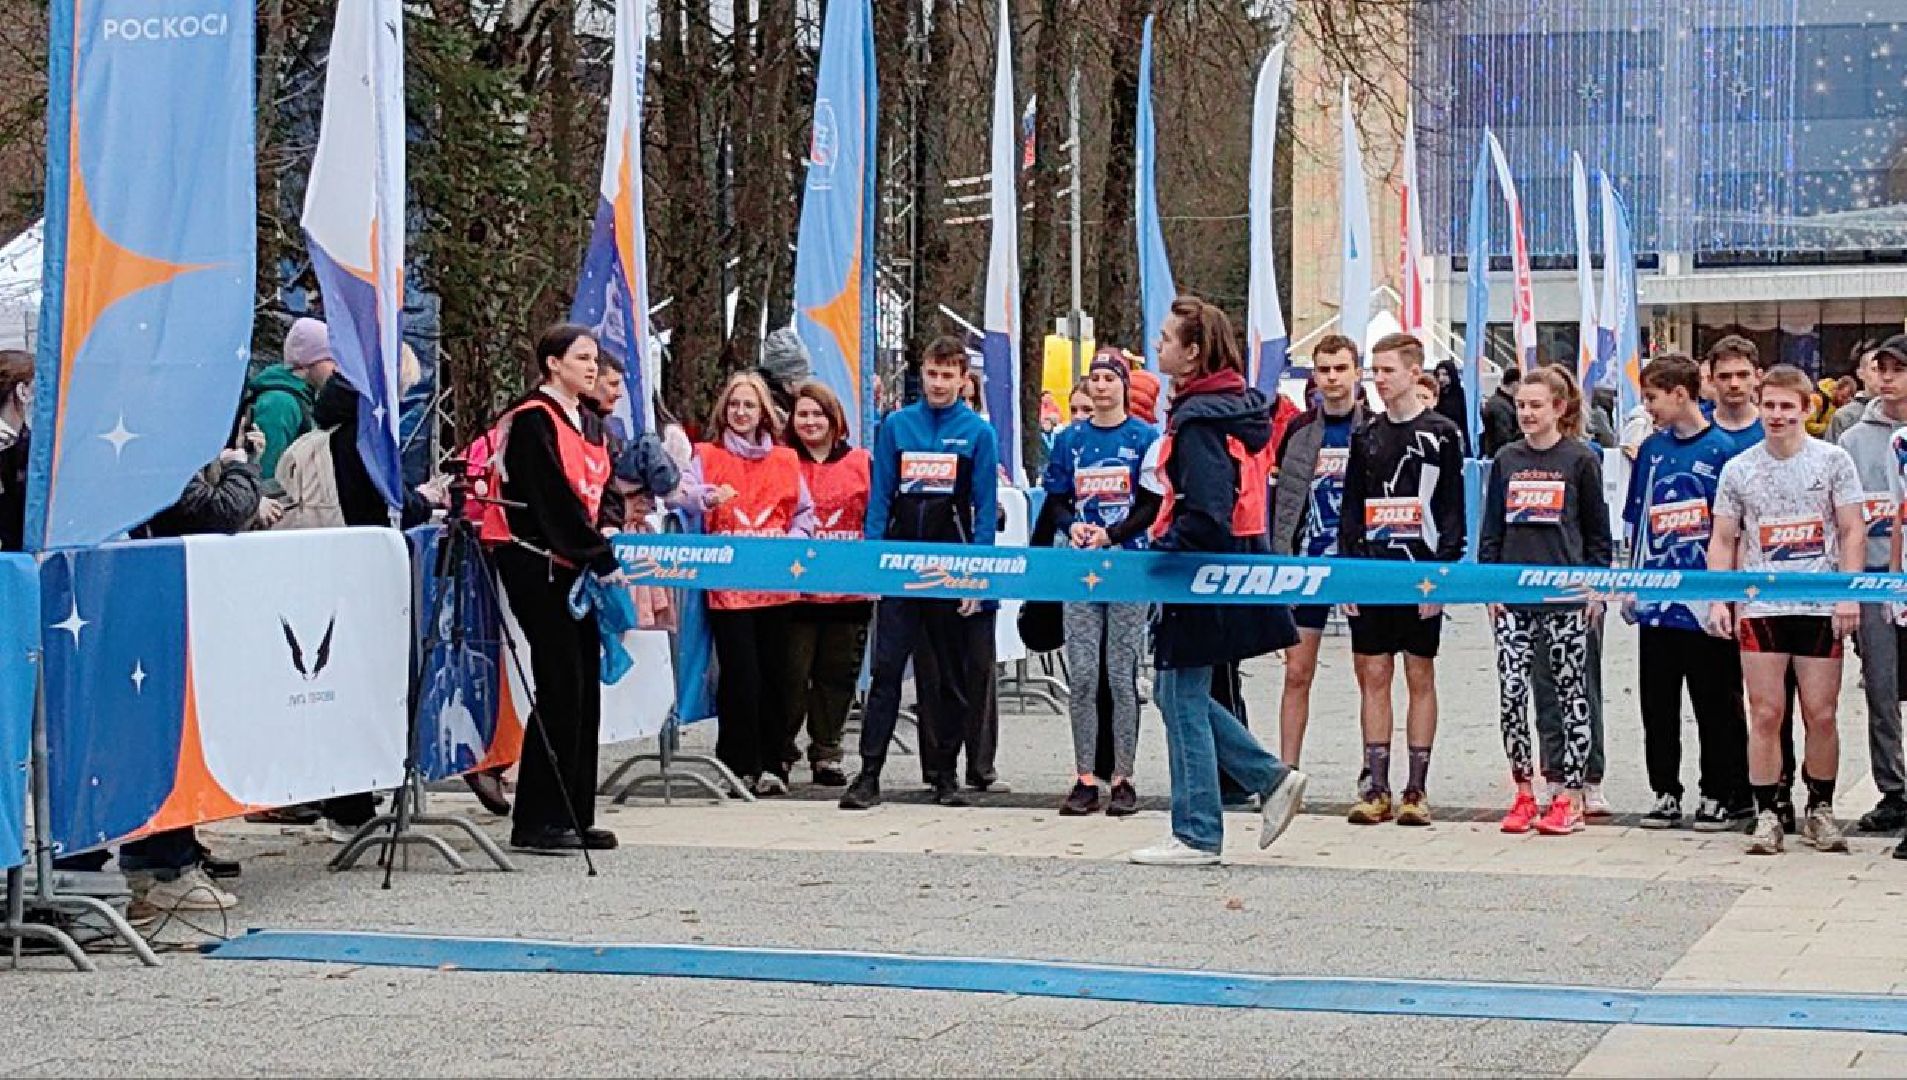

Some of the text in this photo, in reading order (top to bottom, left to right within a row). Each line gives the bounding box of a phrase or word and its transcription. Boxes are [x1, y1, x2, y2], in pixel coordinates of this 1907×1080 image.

[906, 462, 951, 477] 2009
[880, 553, 1027, 574] ГАГАРИНСКИЙ
[1191, 565, 1331, 595] СТАРТ
[1518, 569, 1683, 589] ГАГАРИНСКИЙ
